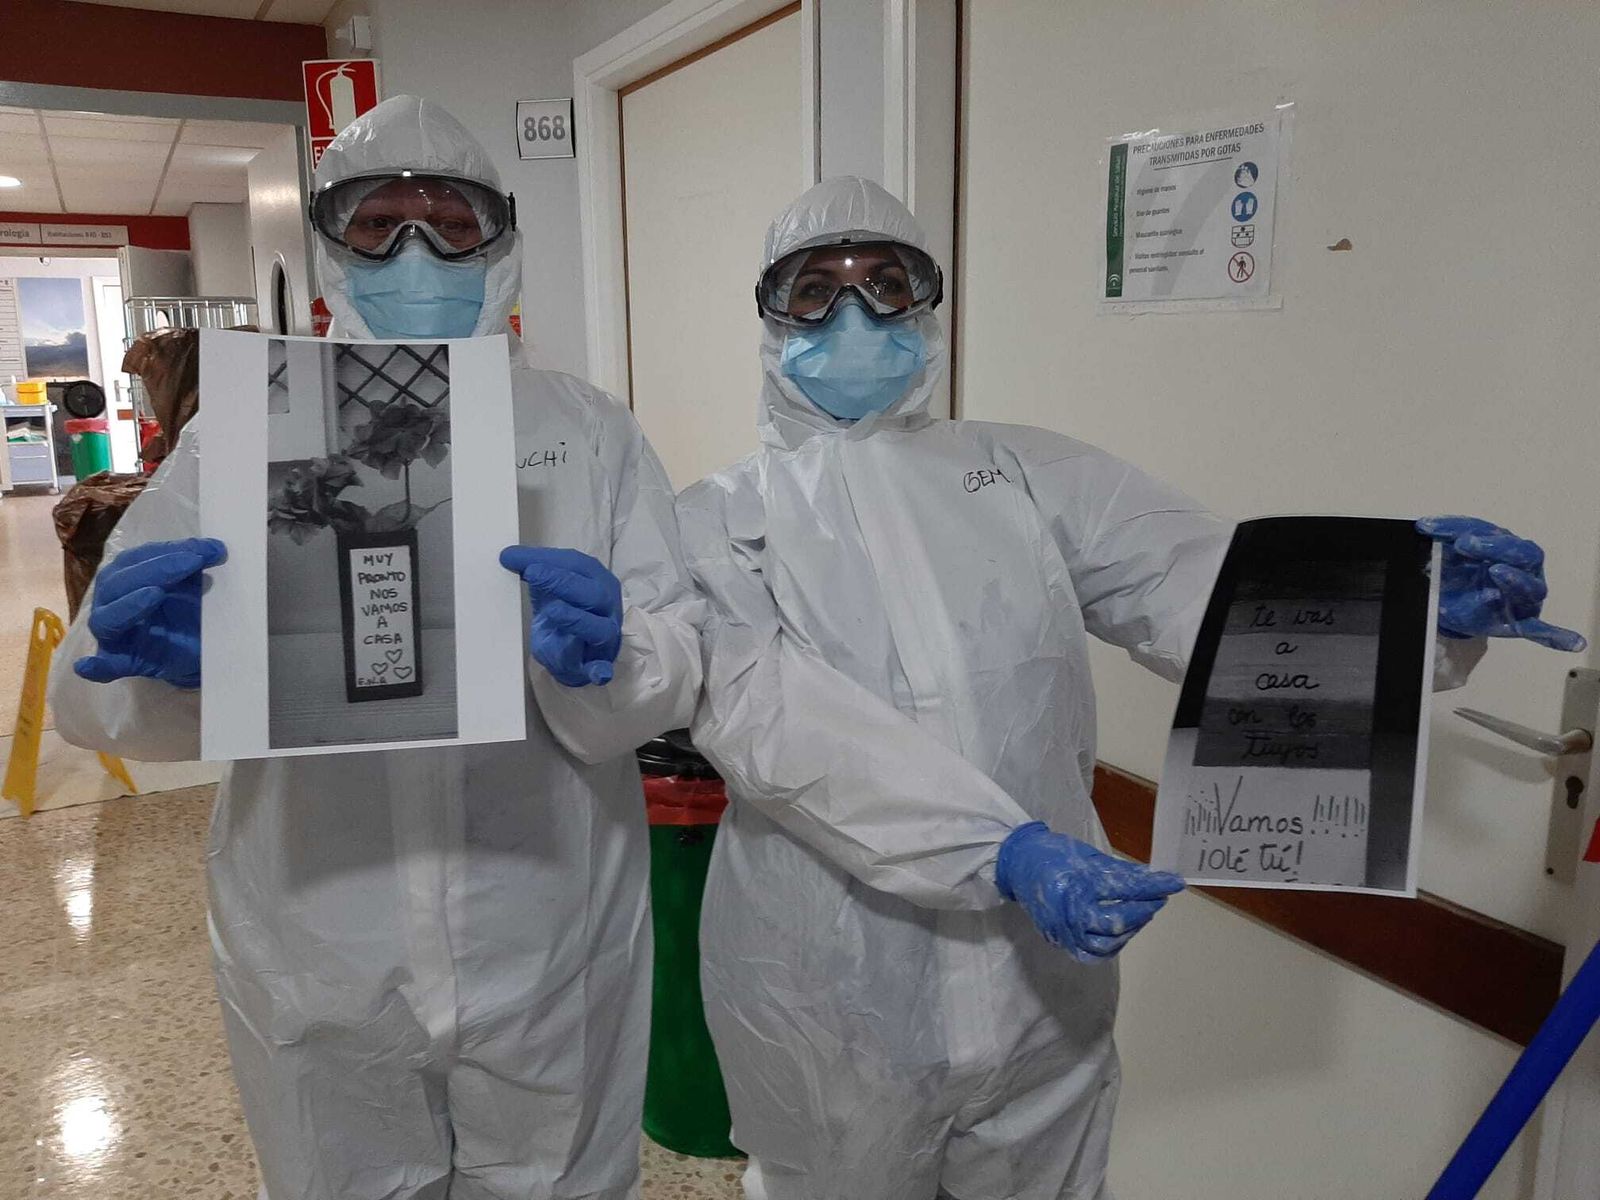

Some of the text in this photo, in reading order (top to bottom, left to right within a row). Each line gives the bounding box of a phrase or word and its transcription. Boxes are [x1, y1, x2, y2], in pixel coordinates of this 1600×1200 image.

[524, 115, 566, 142] 868
[1185, 134, 1205, 146] PARA
[1205, 123, 1265, 143] ENFERMEDADES
[1149, 142, 1241, 166] TRANSMITIDAS POR GOTAS
[363, 553, 394, 566] MUY
[357, 571, 407, 585] PRONTO
[369, 587, 399, 600] NOS
[360, 602, 409, 617] VAMOS
[376, 616, 388, 629] A
[363, 633, 403, 646] CASA
[1275, 641, 1298, 655] a
[1255, 673, 1320, 690] casa
